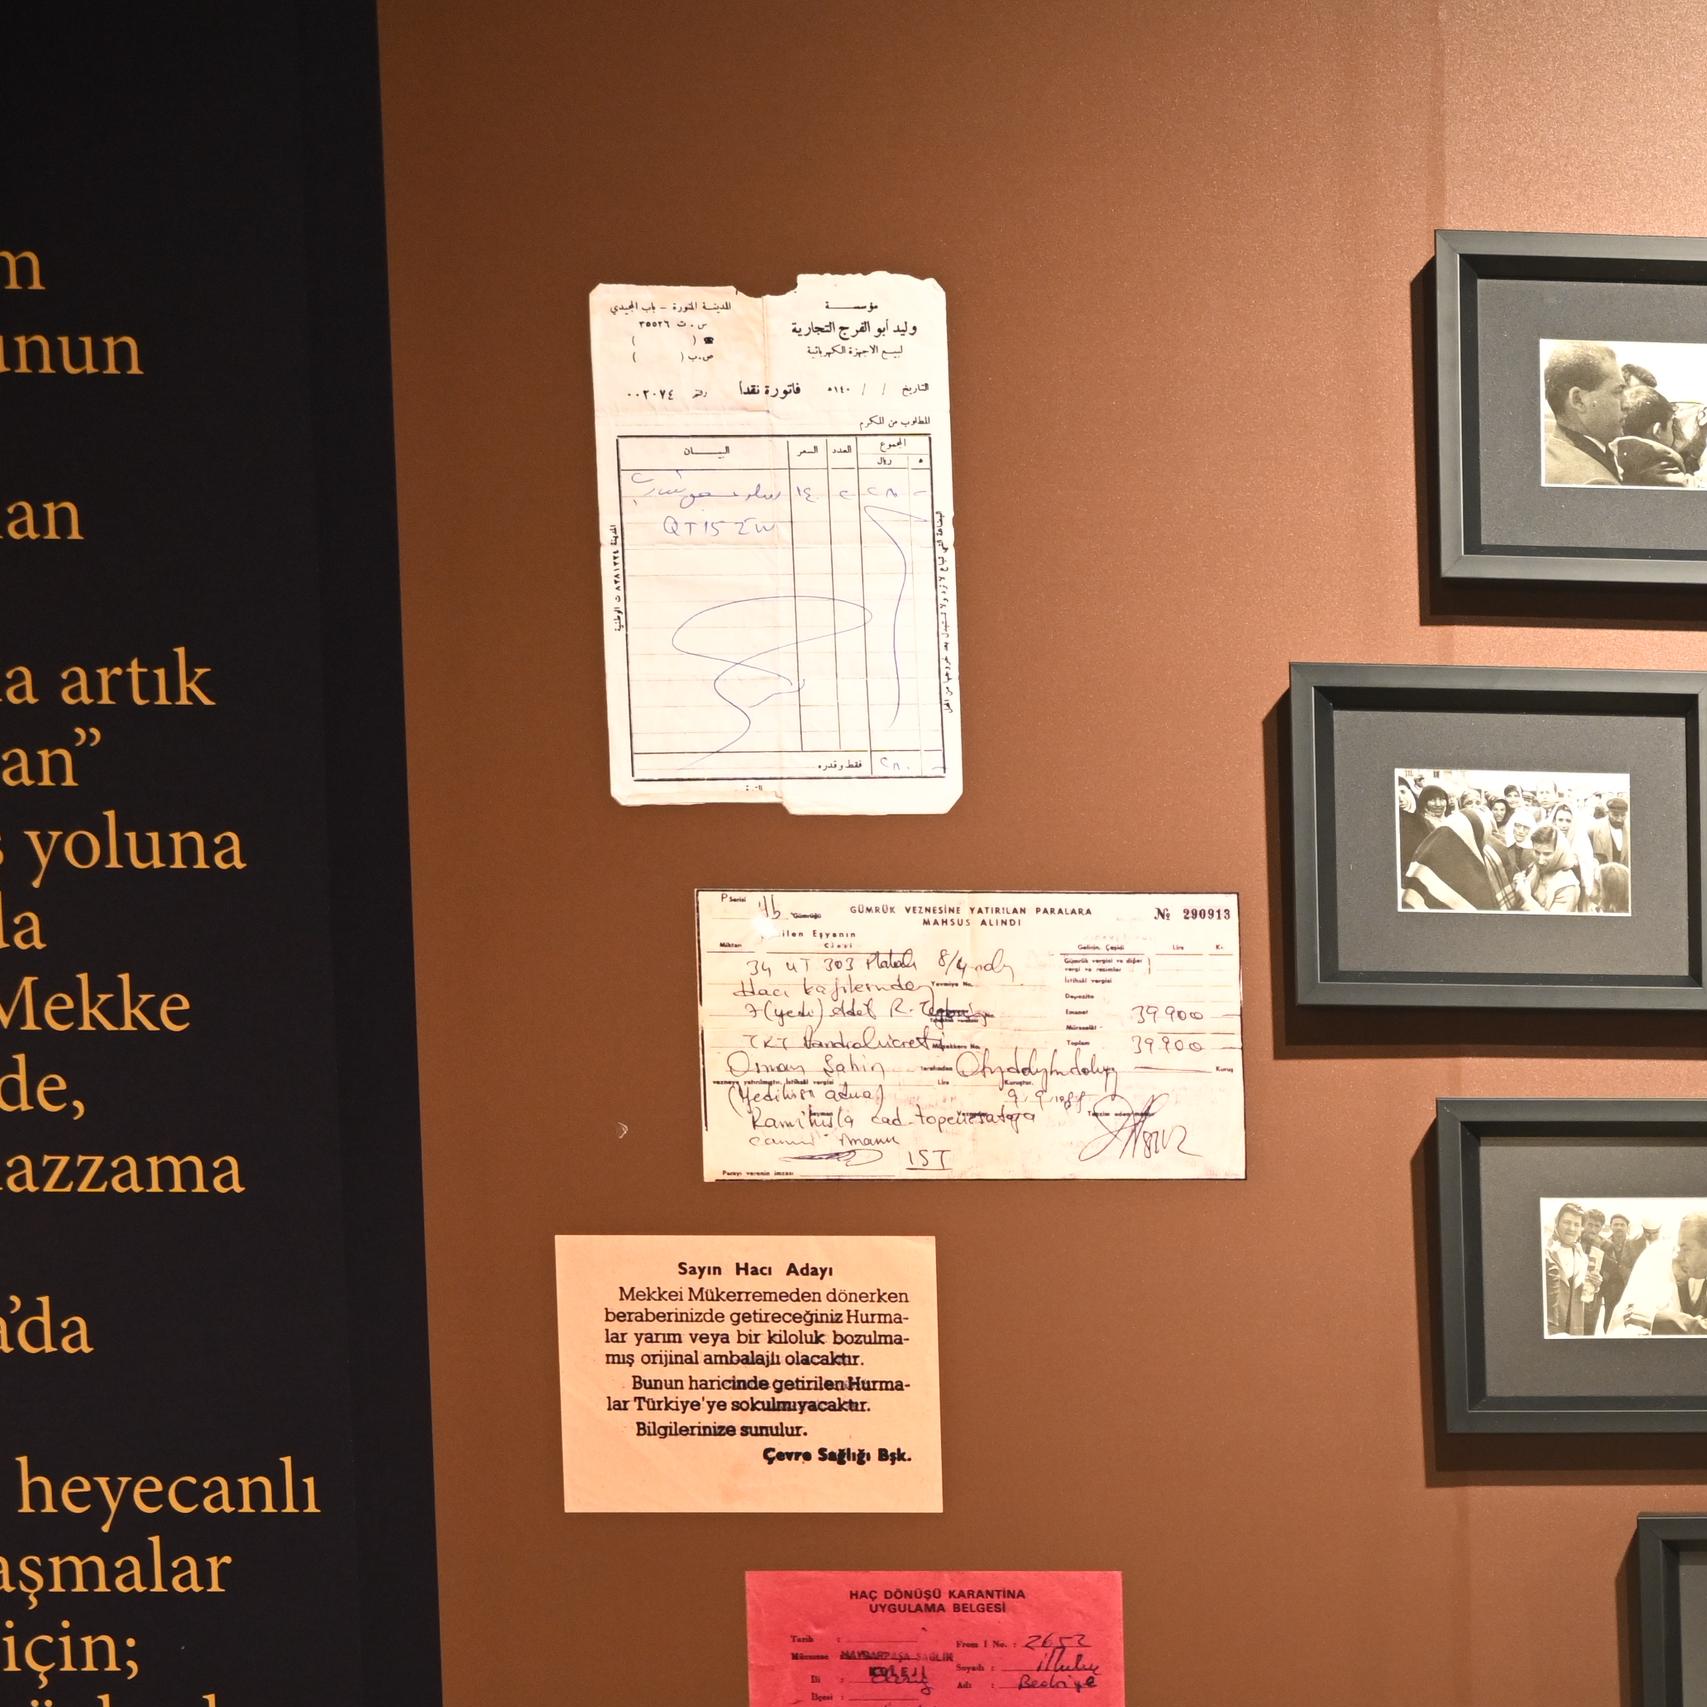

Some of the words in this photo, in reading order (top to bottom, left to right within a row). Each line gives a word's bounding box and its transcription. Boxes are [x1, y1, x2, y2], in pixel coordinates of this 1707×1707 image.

[0, 335, 144, 374] nun
[0, 501, 84, 540] an
[0, 666, 39, 704] a
[61, 646, 216, 706] artık
[28, 810, 247, 888] yoluna
[850, 904, 895, 914] GÜMRÜK
[905, 904, 960, 914] VEZNESİNE
[969, 907, 1026, 915] YATIRILAN
[1035, 907, 1092, 916] PARALARA
[1183, 908, 1230, 920] 290913
[922, 918, 970, 927] MAHSUS
[0, 1154, 246, 1193] azzama
[678, 1262, 722, 1280] Sayın
[735, 1262, 772, 1276] Hacı
[786, 1262, 833, 1280] Adayı
[619, 1286, 684, 1302] Mekkei
[688, 1287, 822, 1303] Mükerremeden
[826, 1288, 909, 1303] dönerken
[604, 1307, 725, 1323] beraberinizde
[730, 1308, 843, 1327] getireceğiniz
[846, 1309, 909, 1324] Hurma-
[605, 1328, 628, 1343] lar
[634, 1332, 683, 1347] yarım
[689, 1333, 730, 1347] veya
[736, 1329, 761, 1344] bir
[767, 1329, 826, 1345] kiloluk
[832, 1330, 910, 1345] bozulma-
[605, 1353, 635, 1367] mış
[641, 1350, 699, 1367] orijinal
[785, 1350, 864, 1366] olacaktır.
[632, 1375, 684, 1390] Bunun
[688, 1375, 771, 1390] haricinde
[772, 1376, 845, 1394] getirilen
[845, 1376, 910, 1391] Hurma-
[606, 1396, 630, 1411] lar
[633, 1396, 727, 1414] Türkiye'ye
[731, 1396, 871, 1415] sokulmıyacaktır.
[636, 1421, 737, 1439] Bilgilerinize
[740, 1422, 808, 1437] sunulur.
[763, 1447, 812, 1465] Çevre
[818, 1447, 871, 1466] Sağlığı
[878, 1447, 912, 1466] Bşk.
[15, 1455, 321, 1533] heyecanlı
[849, 1590, 877, 1602] HAÇ
[884, 1588, 941, 1601] DÖNÜŞÜ
[948, 1588, 1026, 1599] KARANTİNA
[869, 1603, 946, 1614] UYGULAMA
[953, 1601, 1006, 1613] BELGESİ
[2, 1635, 138, 1689] için;
